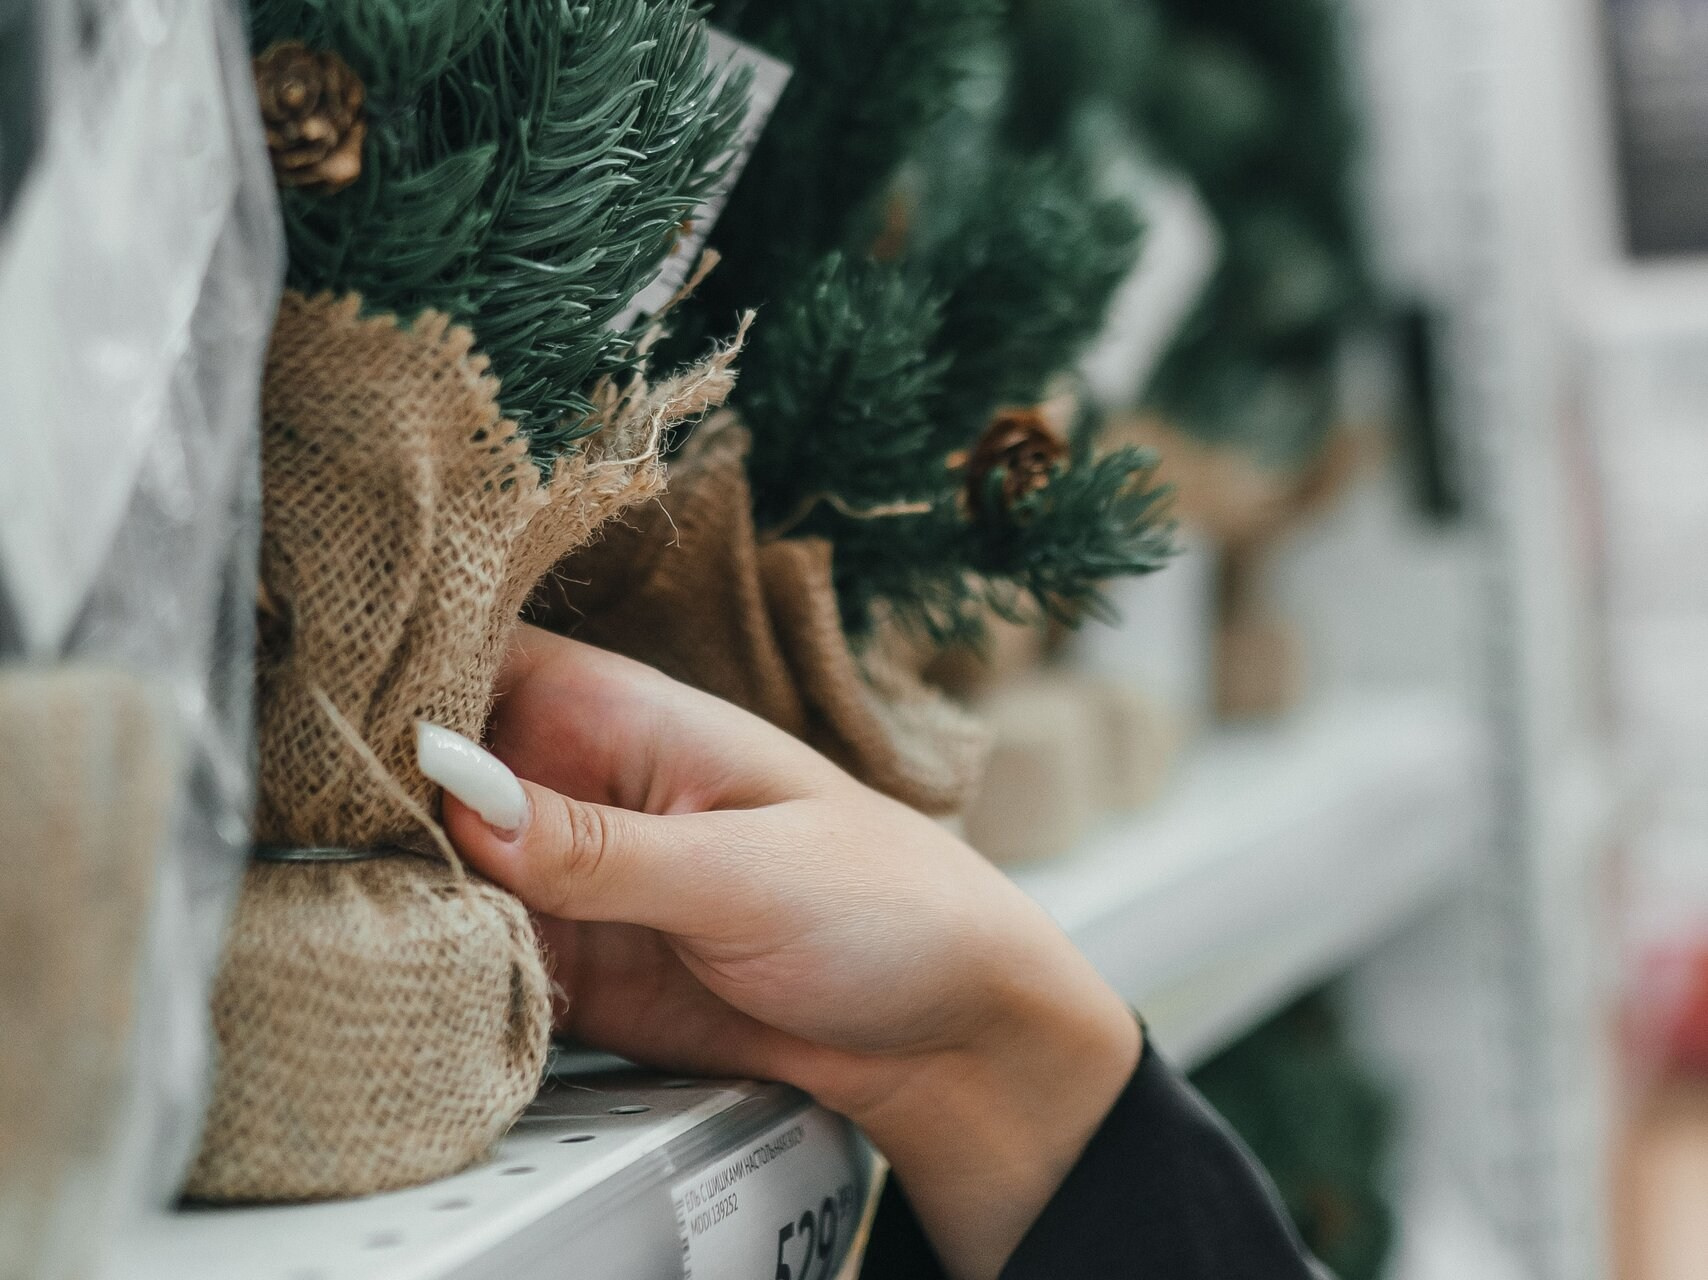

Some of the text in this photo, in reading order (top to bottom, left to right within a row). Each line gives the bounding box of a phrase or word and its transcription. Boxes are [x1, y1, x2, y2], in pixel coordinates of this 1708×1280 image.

[684, 1190, 701, 1213] ЕЛЬ
[706, 1161, 745, 1200] ШИШКАМИ
[711, 1192, 739, 1225] 139252
